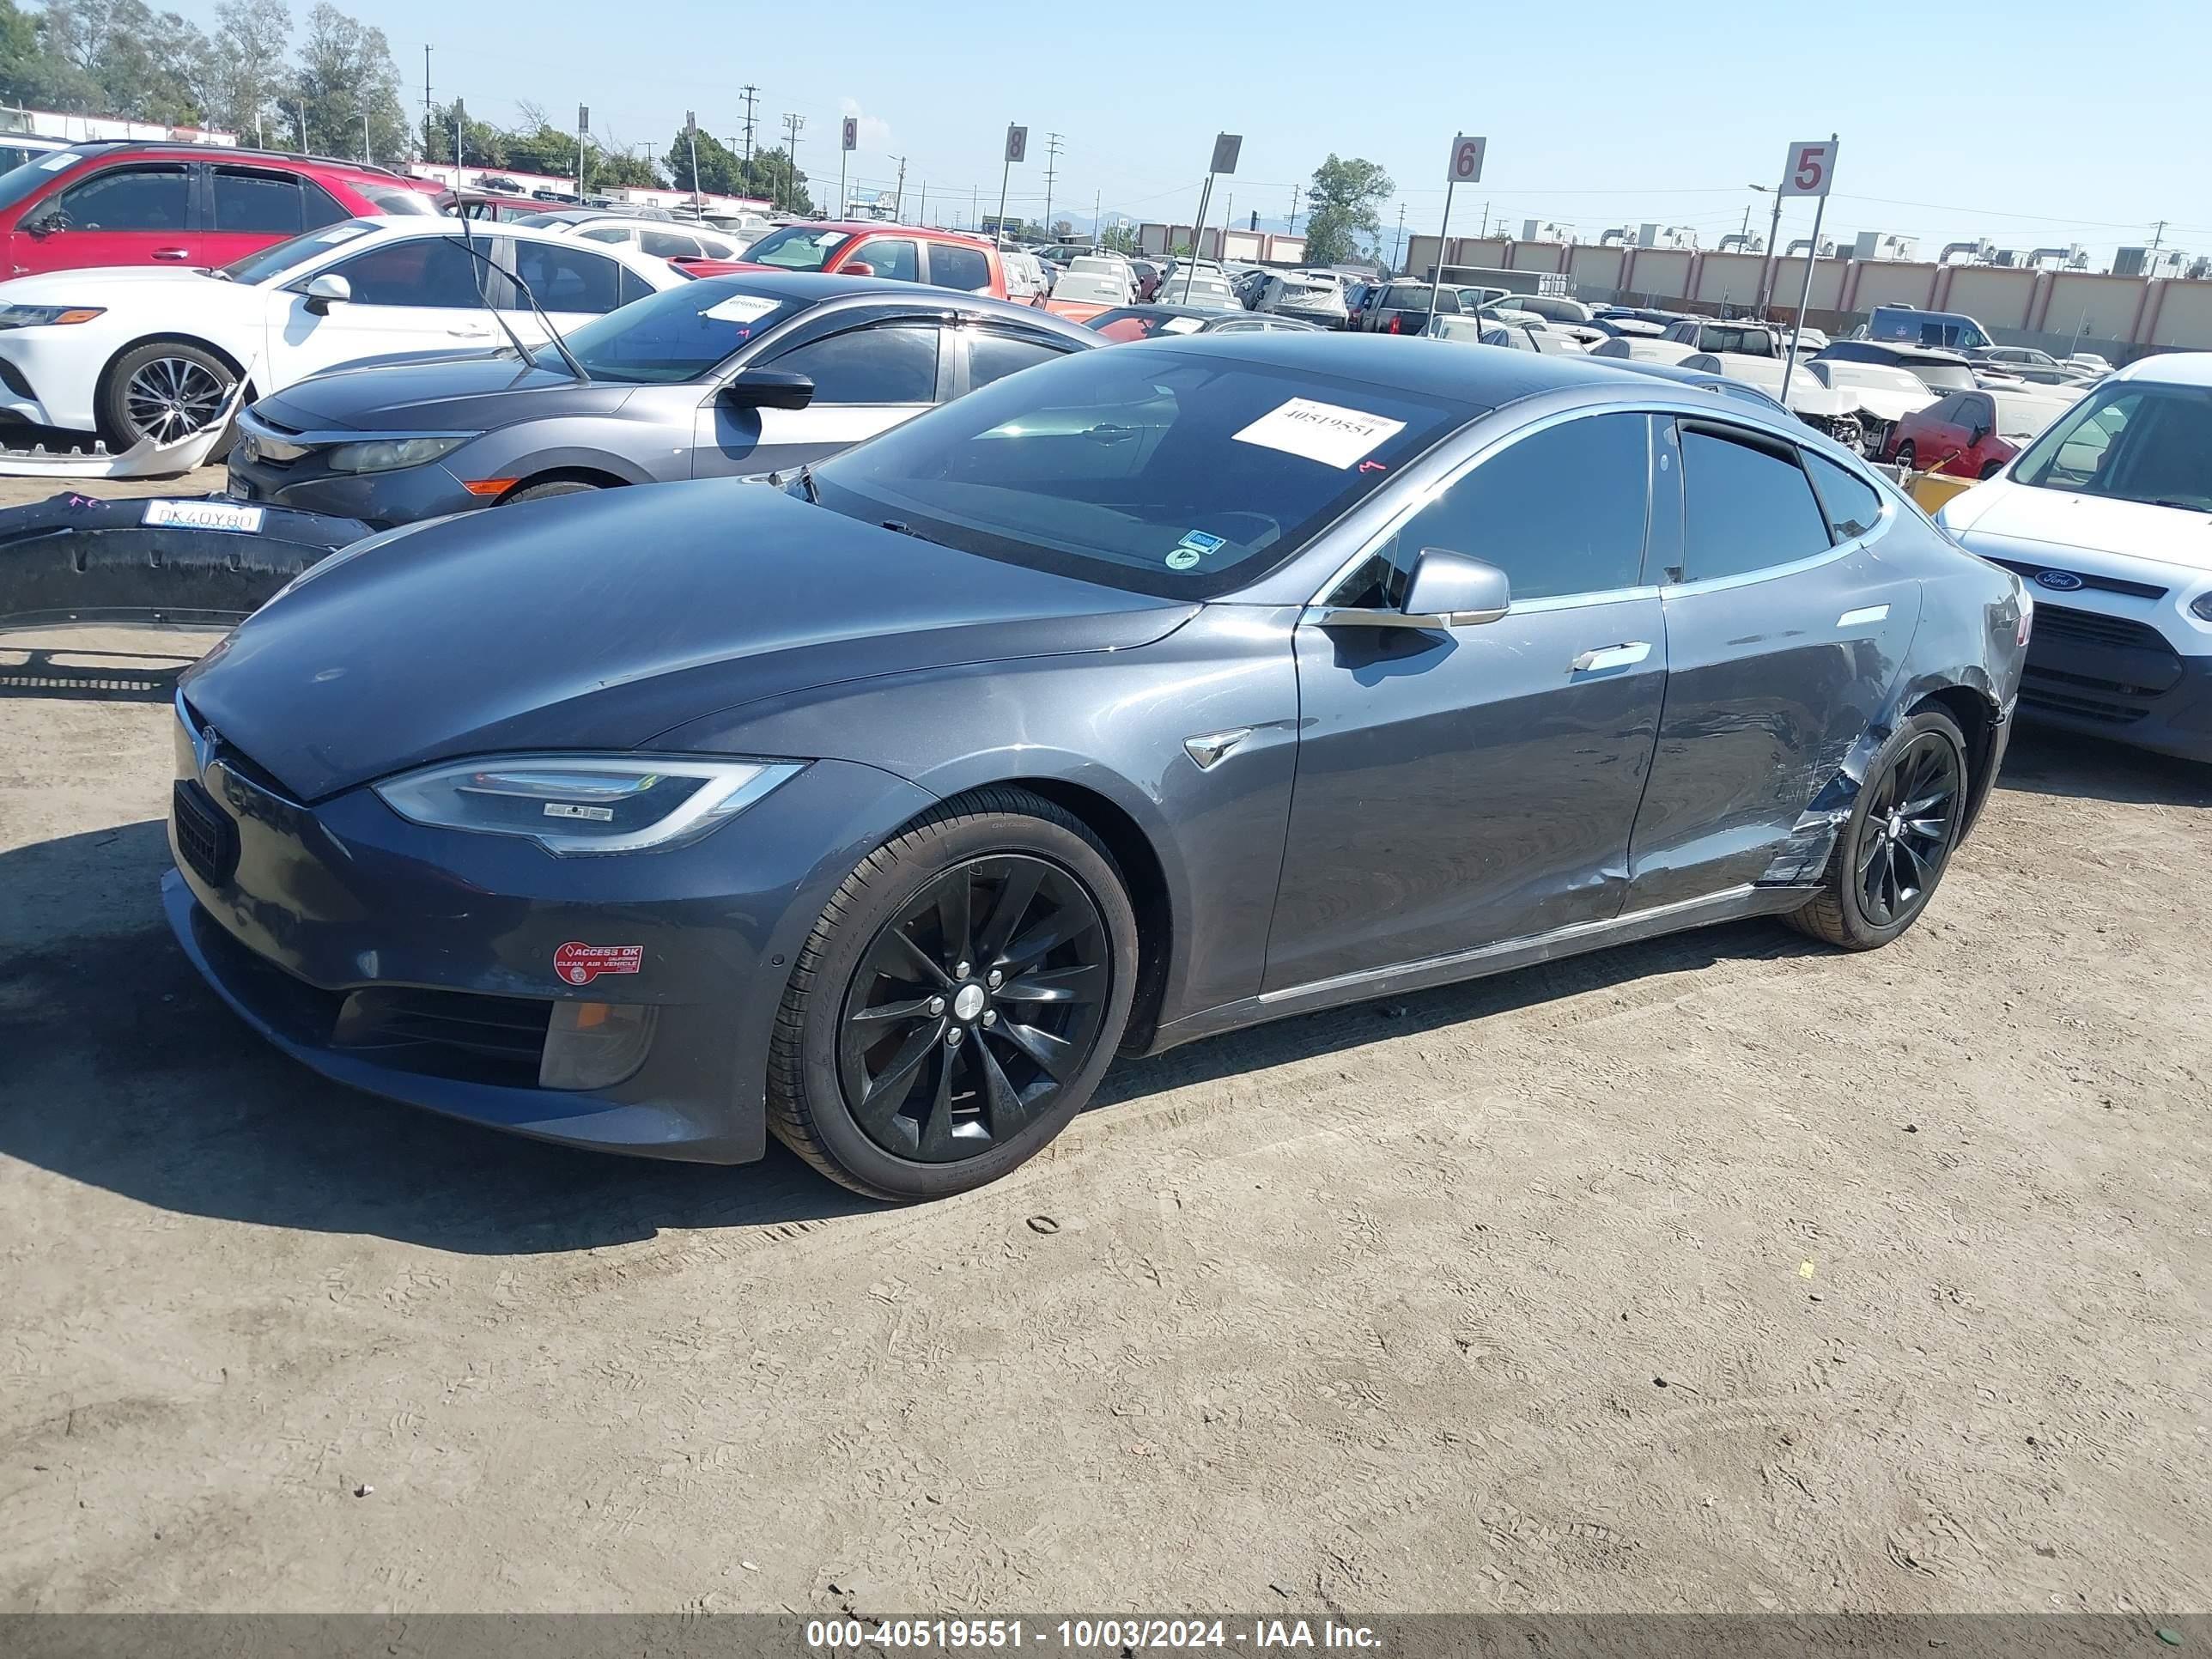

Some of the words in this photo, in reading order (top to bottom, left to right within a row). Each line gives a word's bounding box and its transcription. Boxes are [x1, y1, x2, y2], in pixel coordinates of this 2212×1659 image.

[845, 122, 854, 147] 9
[1010, 131, 1022, 158] 8
[1456, 143, 1476, 177] 6
[1795, 149, 1825, 190] 5
[1285, 410, 1375, 436] 40519551
[2044, 573, 2070, 585] Ford
